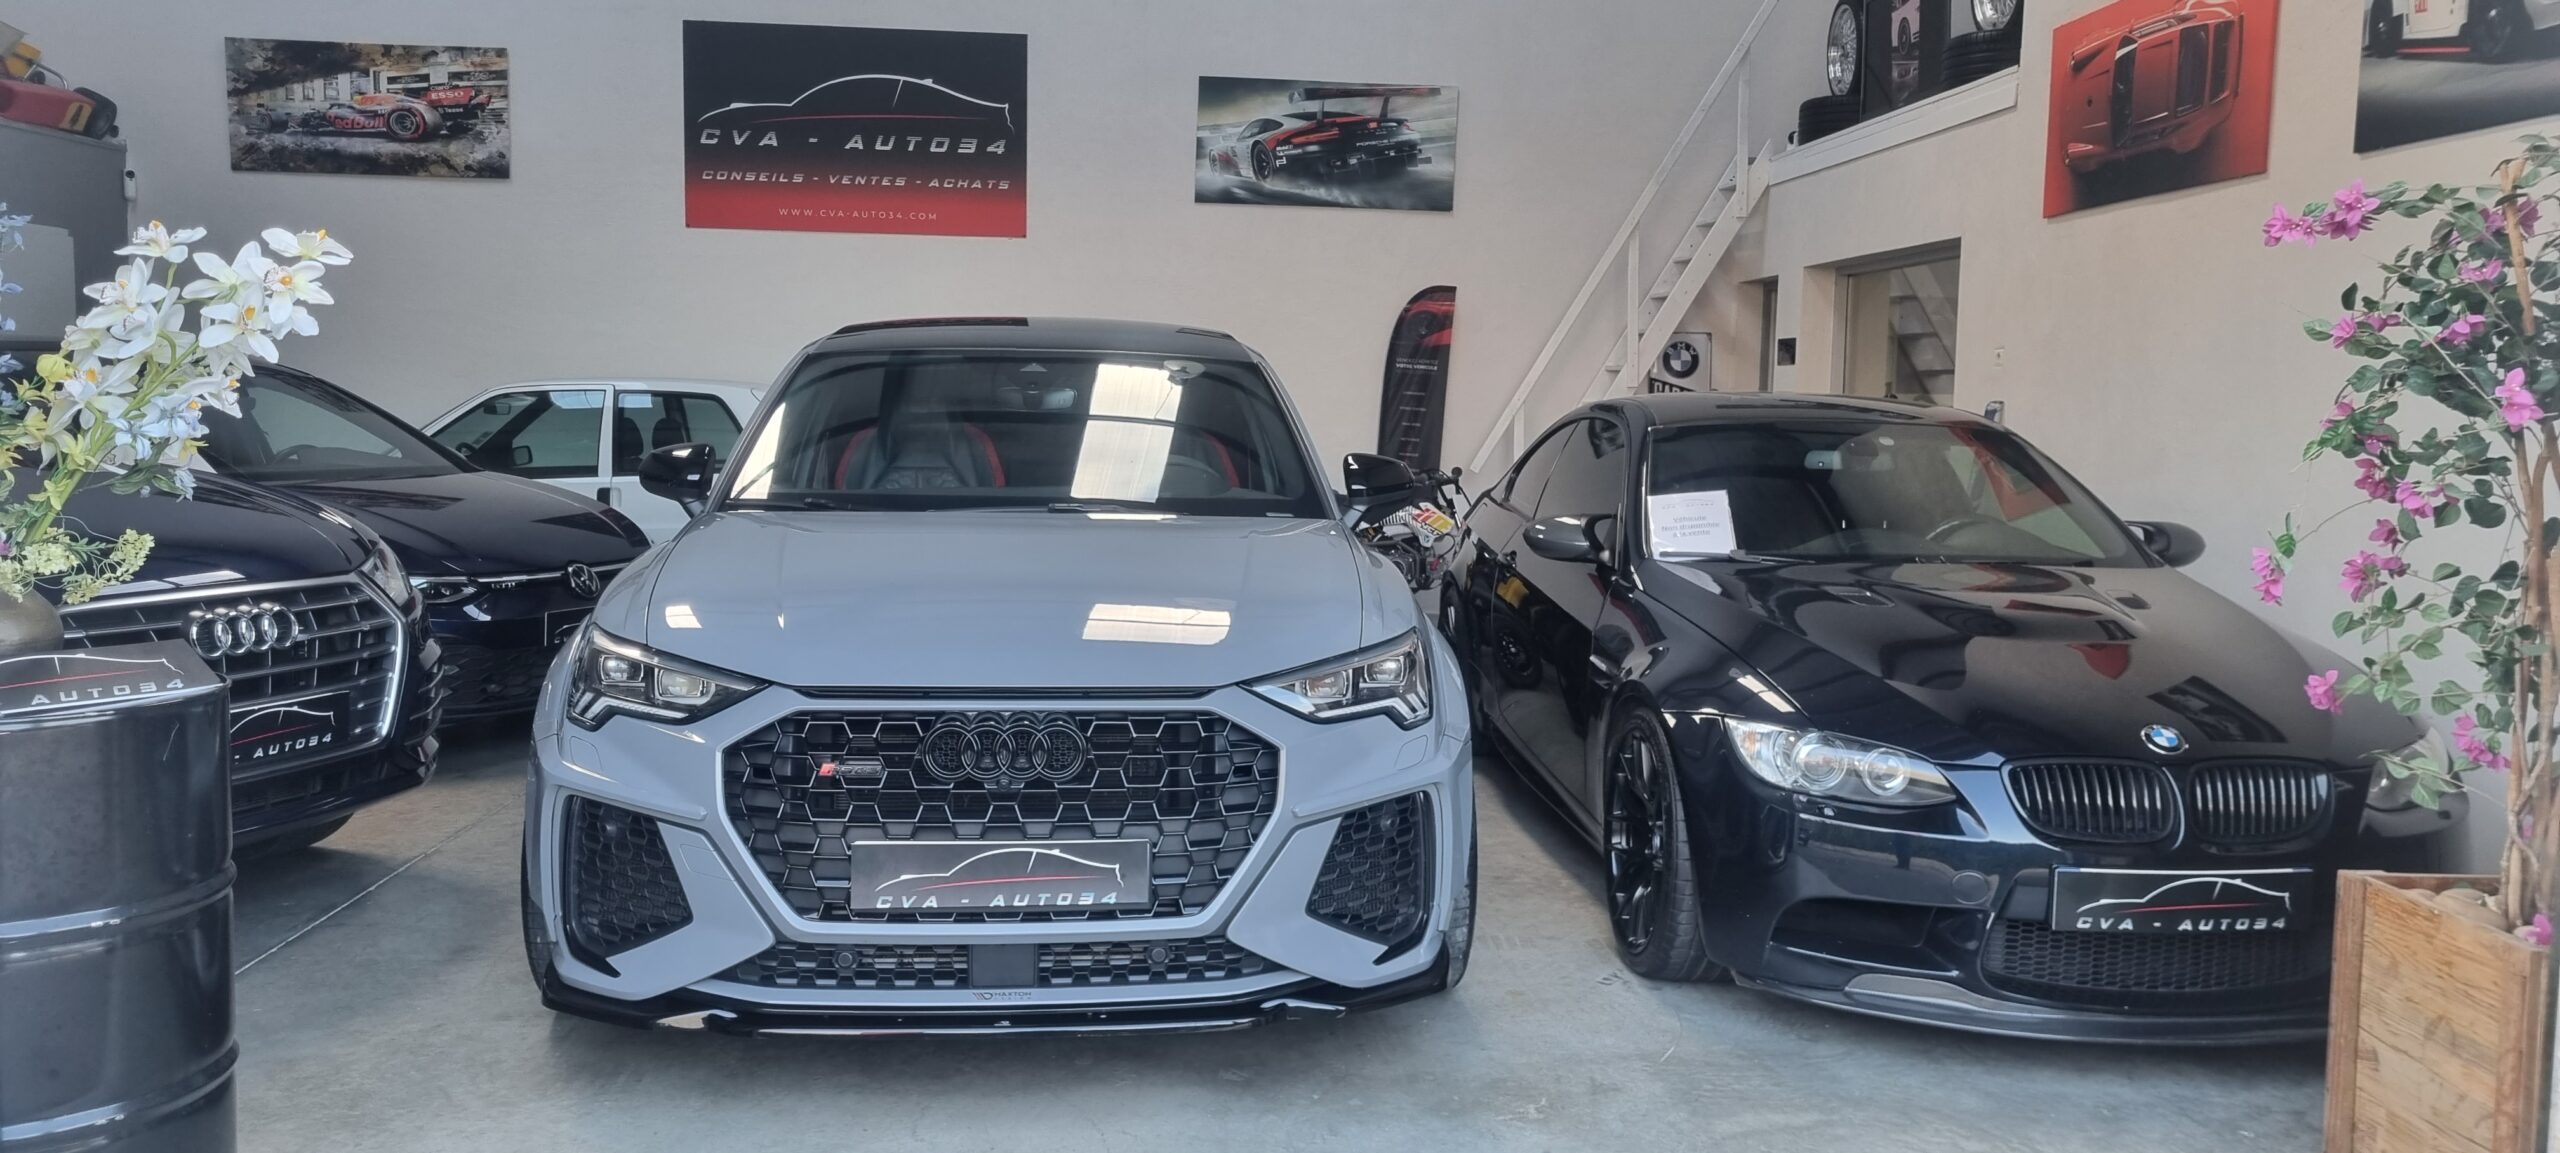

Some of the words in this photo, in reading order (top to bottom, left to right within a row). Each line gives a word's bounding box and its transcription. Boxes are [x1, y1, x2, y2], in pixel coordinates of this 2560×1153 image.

[431, 90, 464, 99] ESSO
[699, 128, 780, 148] CVA
[843, 134, 1008, 156] AUTO34
[701, 169, 805, 184] CONSEILS
[828, 173, 908, 188] VENTES
[928, 177, 1011, 191] ACHATS
[778, 207, 938, 221] WWW.CVA-AUTO34.COM
[1666, 342, 1698, 356] BMW
[31, 677, 185, 706] AUTO34
[253, 732, 333, 759] AUTO34
[876, 894, 938, 909] CVA
[989, 891, 1118, 909] AUTO34
[2076, 916, 2134, 931] CVA
[2176, 916, 2287, 931] AUTO34
